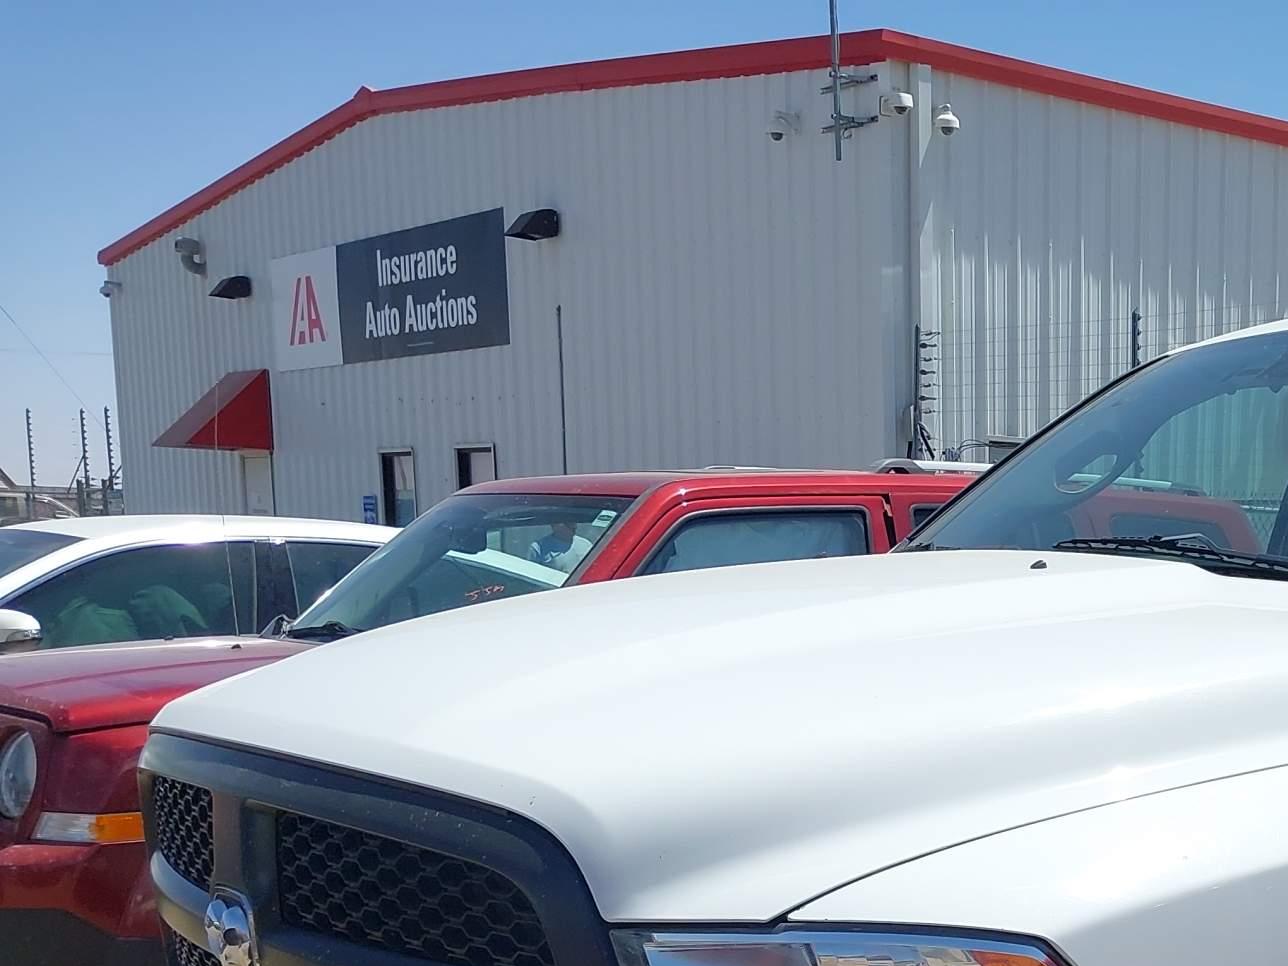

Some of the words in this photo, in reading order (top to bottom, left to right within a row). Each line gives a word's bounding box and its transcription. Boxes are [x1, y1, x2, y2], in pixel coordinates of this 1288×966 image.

[376, 244, 457, 287] Insurance
[365, 301, 400, 339] Auto
[404, 289, 478, 333] Auctions
